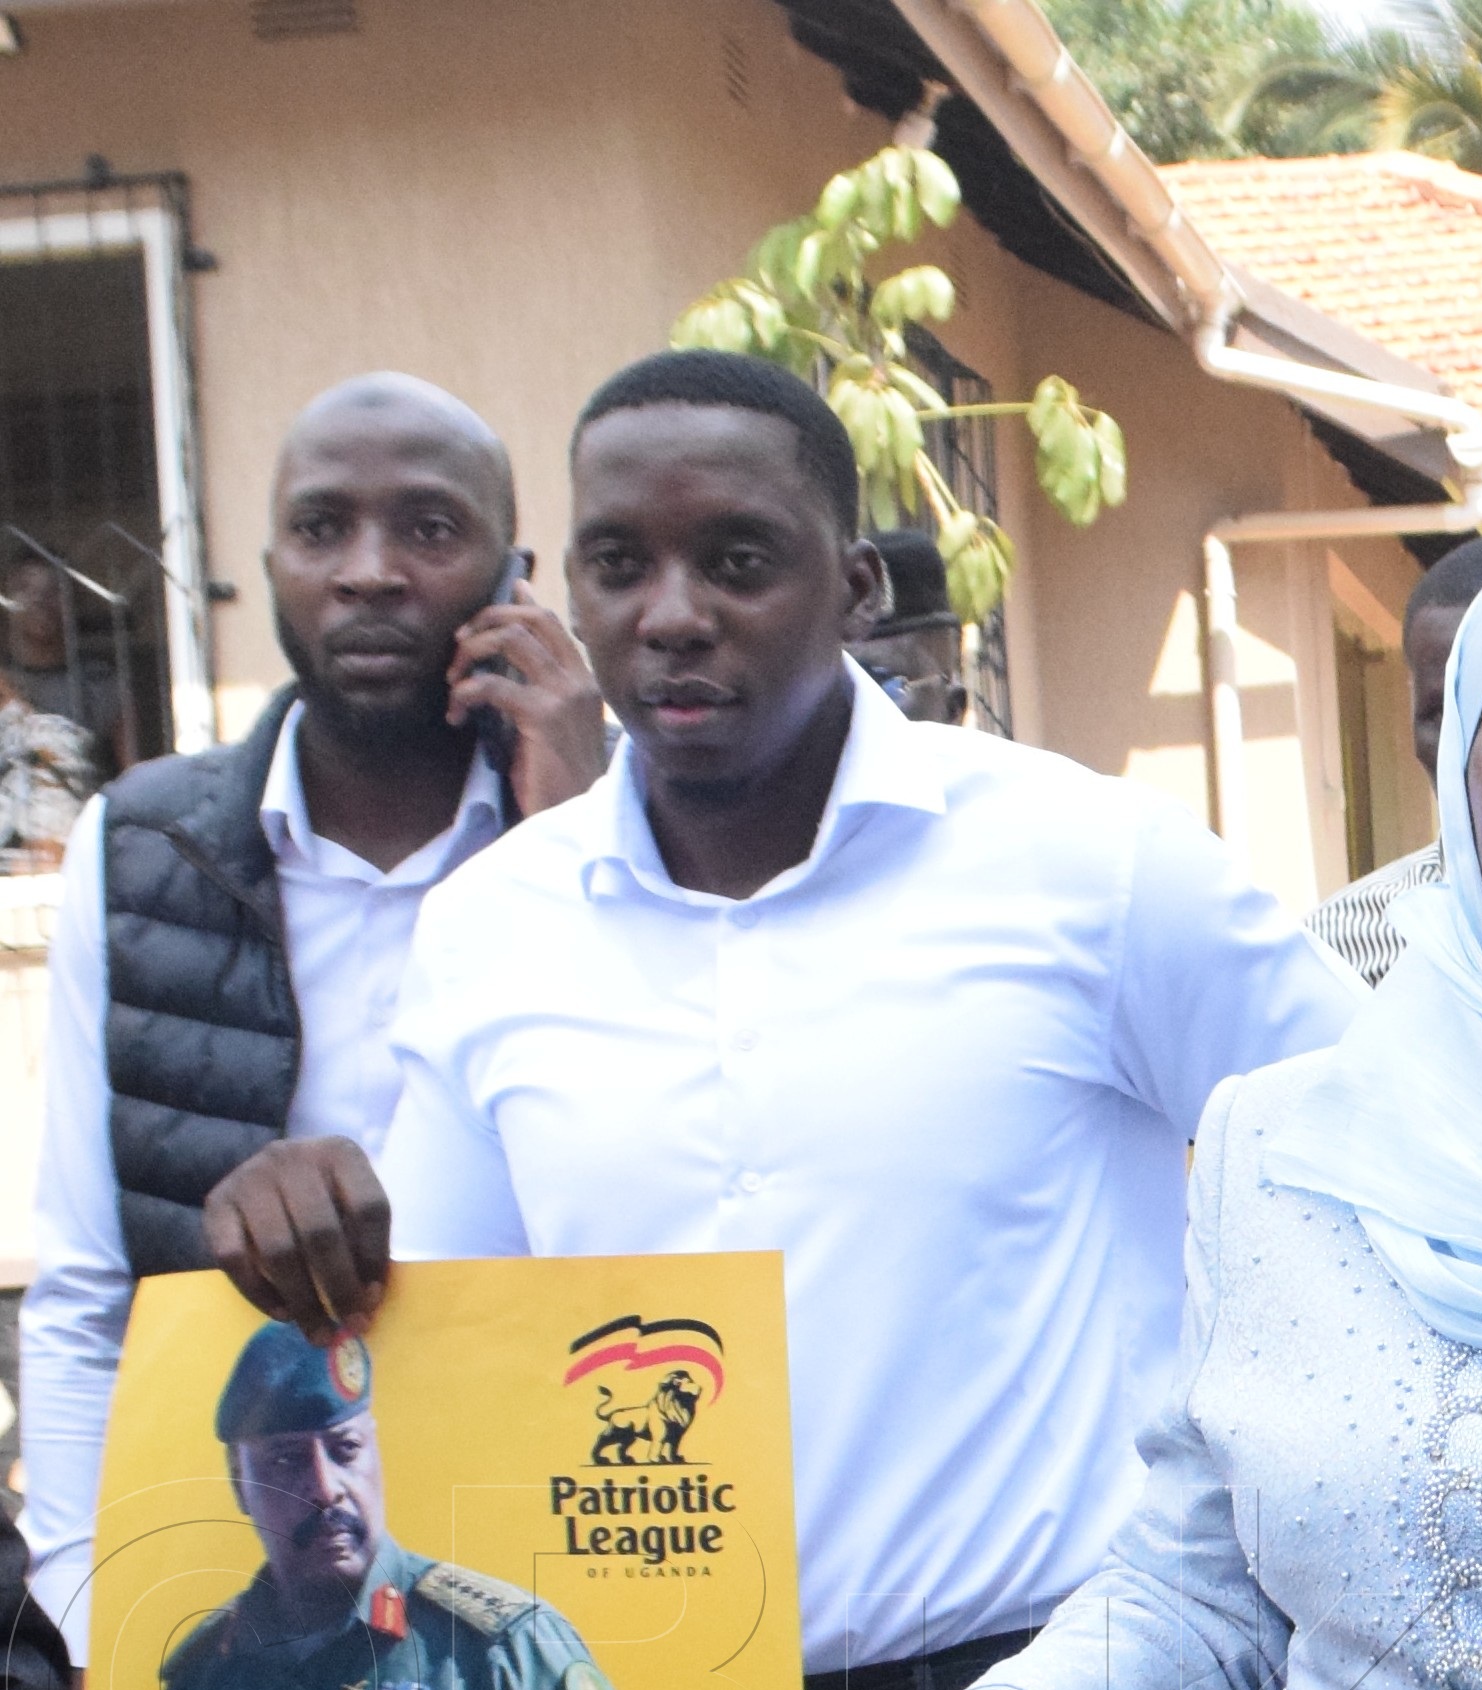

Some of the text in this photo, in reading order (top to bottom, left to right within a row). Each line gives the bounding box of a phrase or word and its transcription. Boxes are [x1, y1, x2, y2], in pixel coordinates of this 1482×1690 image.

[550, 1474, 737, 1515] Patriotic
[566, 1516, 724, 1565] League
[587, 1566, 712, 1579] OF UGANDA
